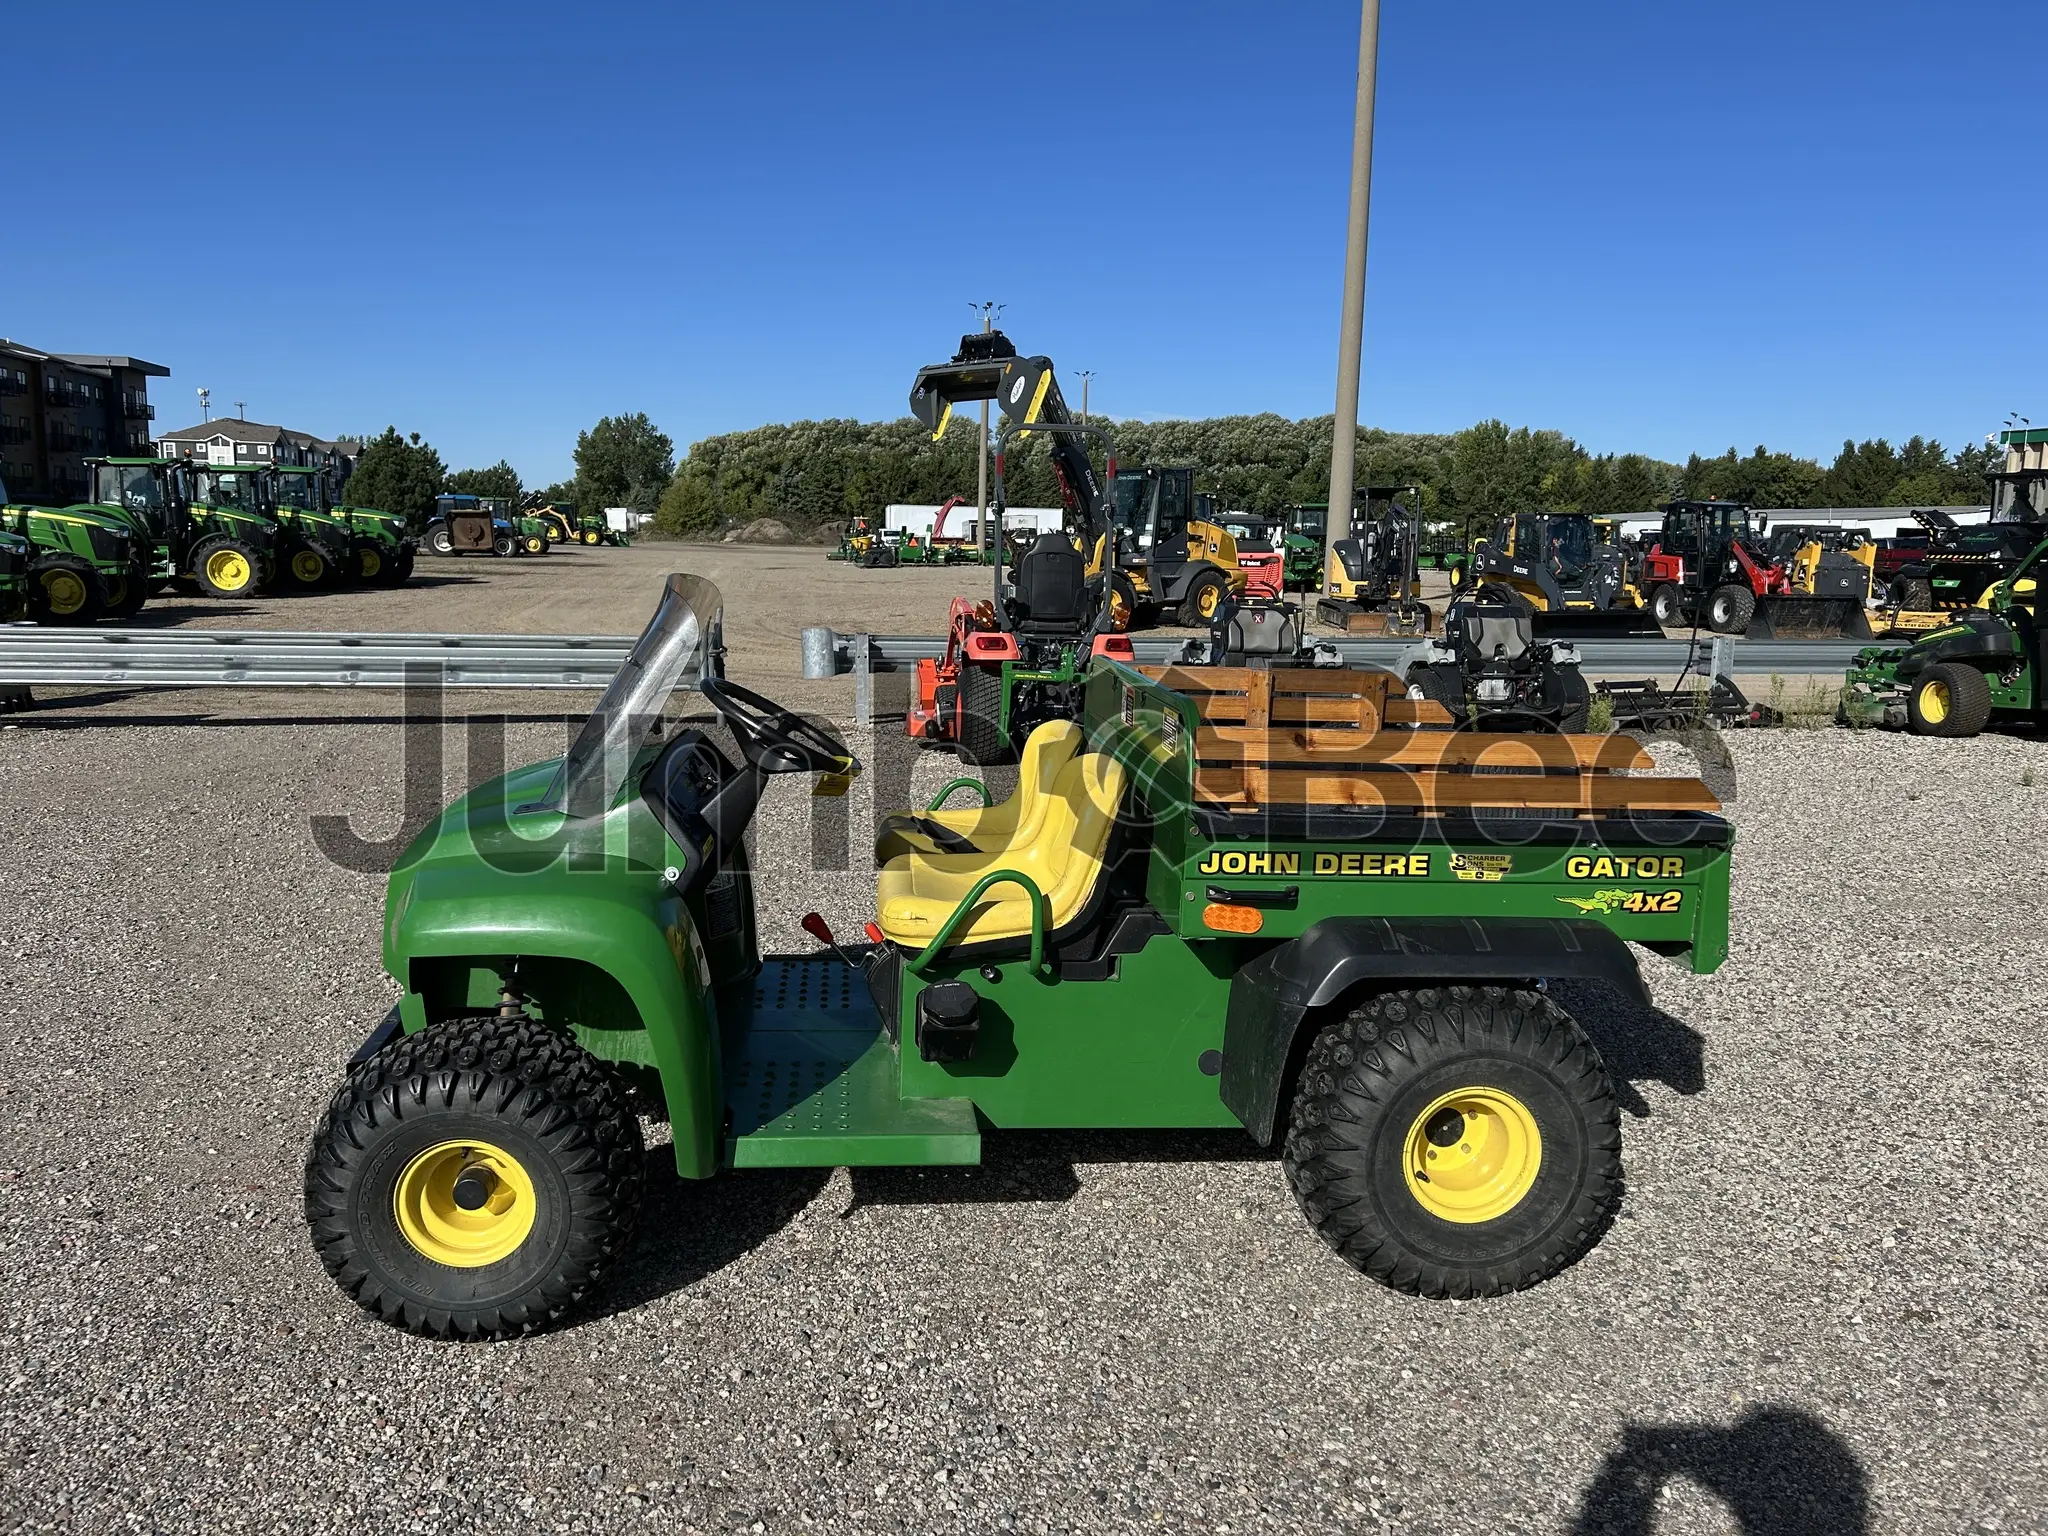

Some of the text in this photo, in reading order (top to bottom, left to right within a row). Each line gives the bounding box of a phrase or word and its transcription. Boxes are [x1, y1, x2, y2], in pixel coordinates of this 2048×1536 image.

[1085, 469, 1099, 497] DEERE
[1513, 565, 1529, 575] DEERE
[1199, 851, 1430, 876] JOHN DEERE
[1566, 856, 1684, 879] GATOR
[1621, 890, 1683, 914] 4x2
[359, 1141, 436, 1297] HD FIELD TRAX
[1408, 1231, 1468, 1259] TRAX
